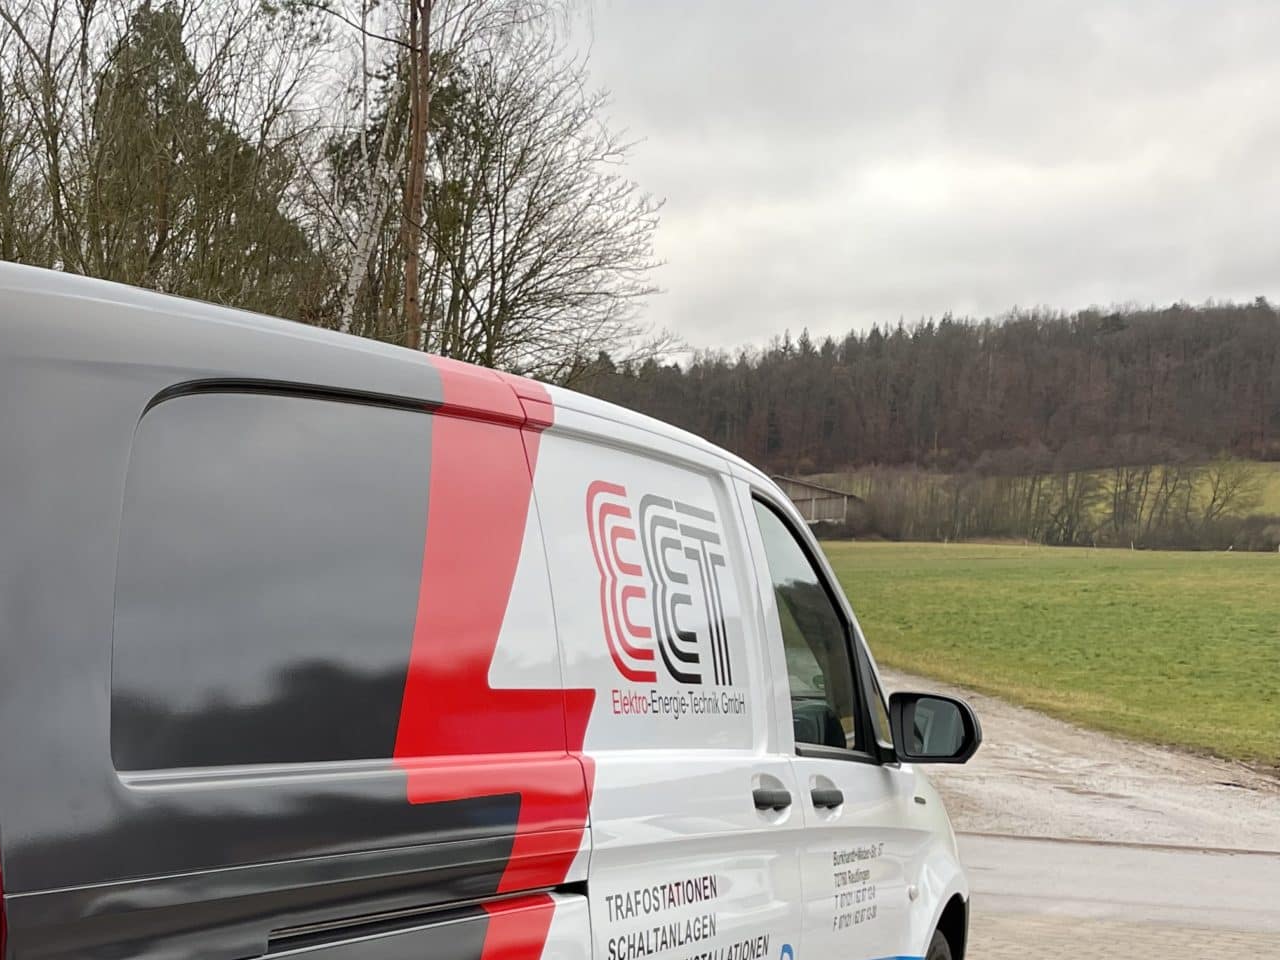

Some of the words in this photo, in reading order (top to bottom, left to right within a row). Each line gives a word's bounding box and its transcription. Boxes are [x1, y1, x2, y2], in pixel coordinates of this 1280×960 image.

[586, 480, 733, 686] EET
[612, 689, 720, 720] Elektro-Energie-Technik
[721, 691, 746, 716] GmbH
[605, 874, 718, 922] TRAFOSTATIONEN
